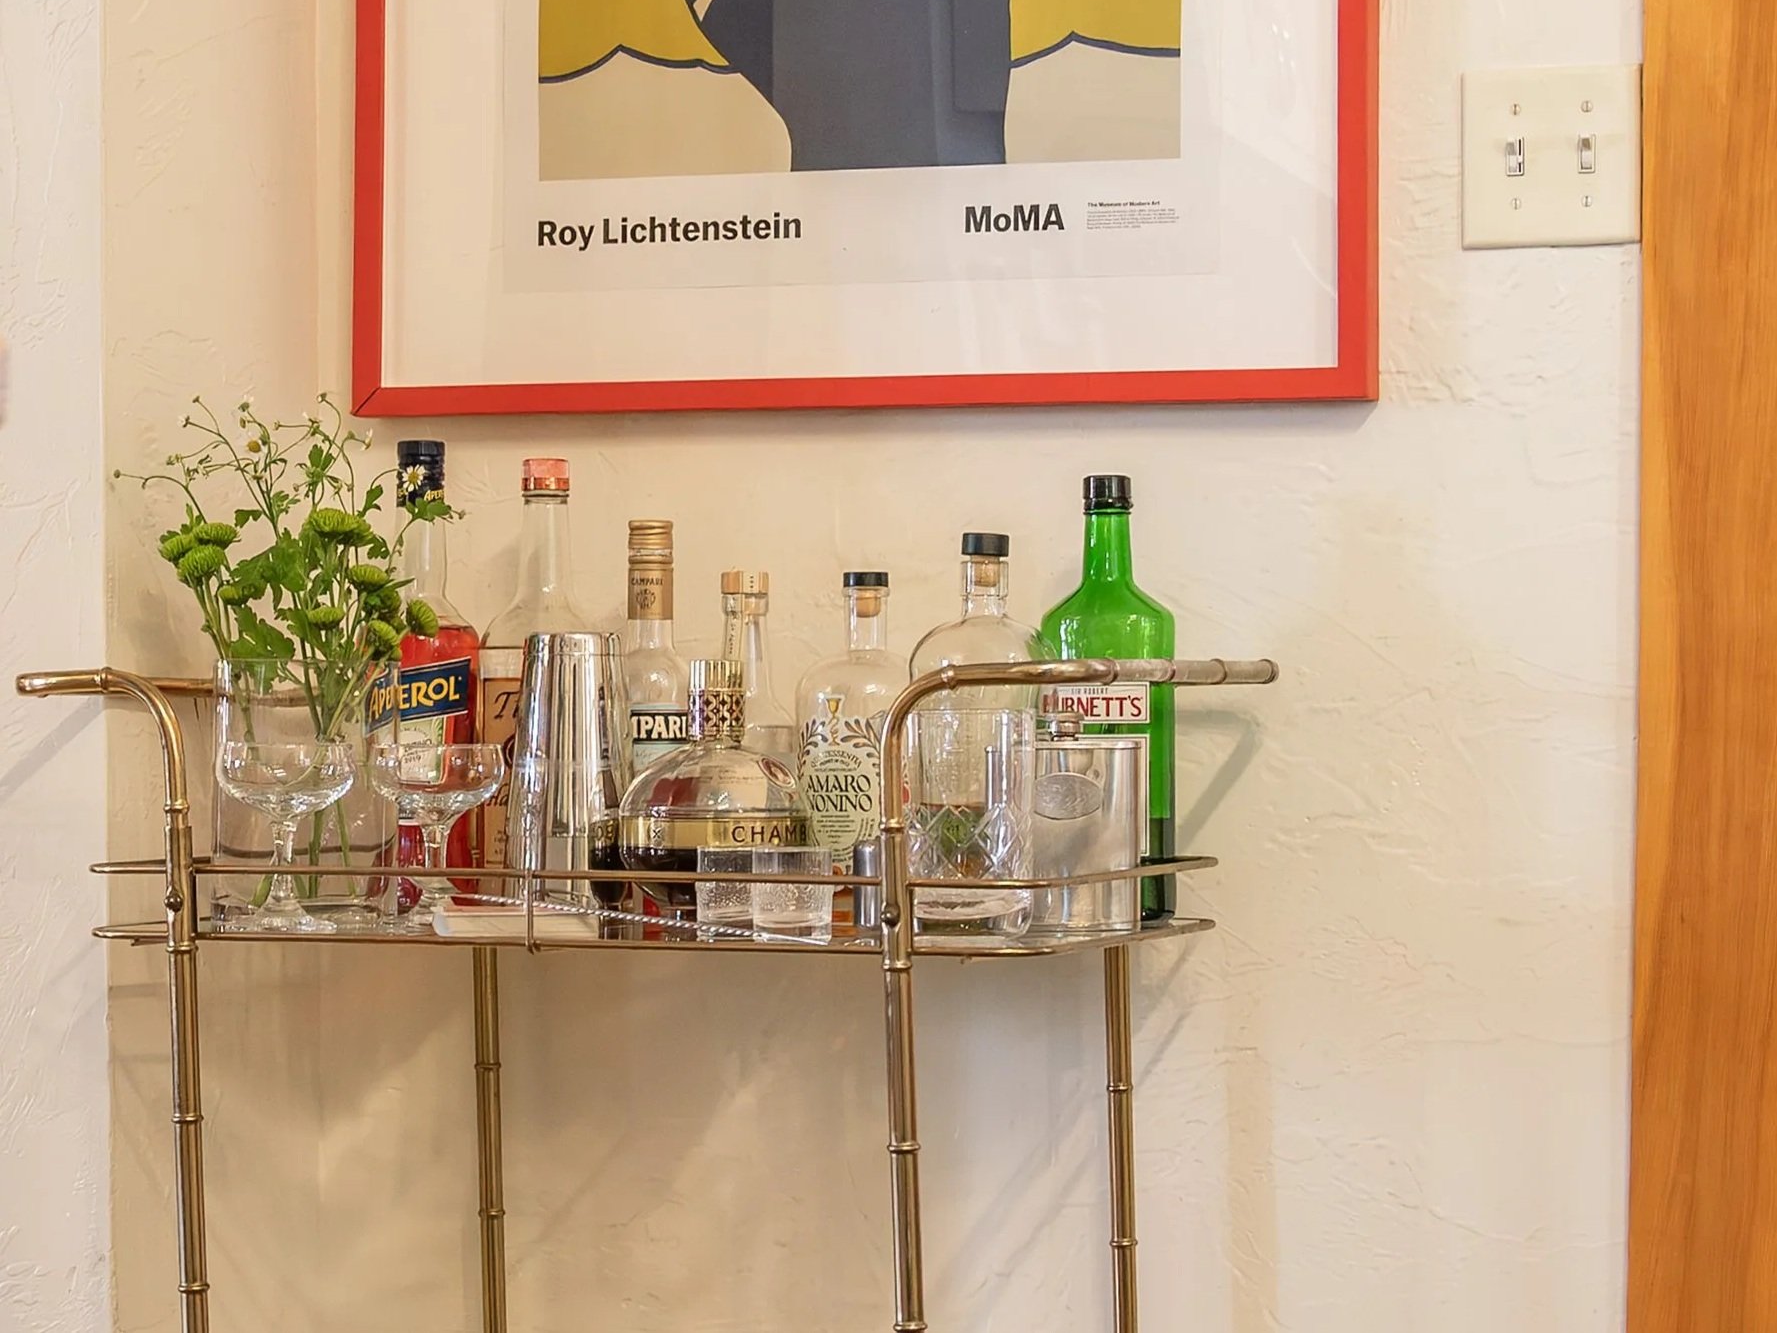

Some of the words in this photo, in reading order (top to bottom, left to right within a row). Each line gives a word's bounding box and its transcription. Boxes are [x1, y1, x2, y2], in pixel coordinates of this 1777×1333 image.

[537, 220, 595, 252] Roy
[602, 212, 802, 245] Lichtenstein
[964, 203, 1065, 233] MoMA
[806, 774, 872, 793] AMARO
